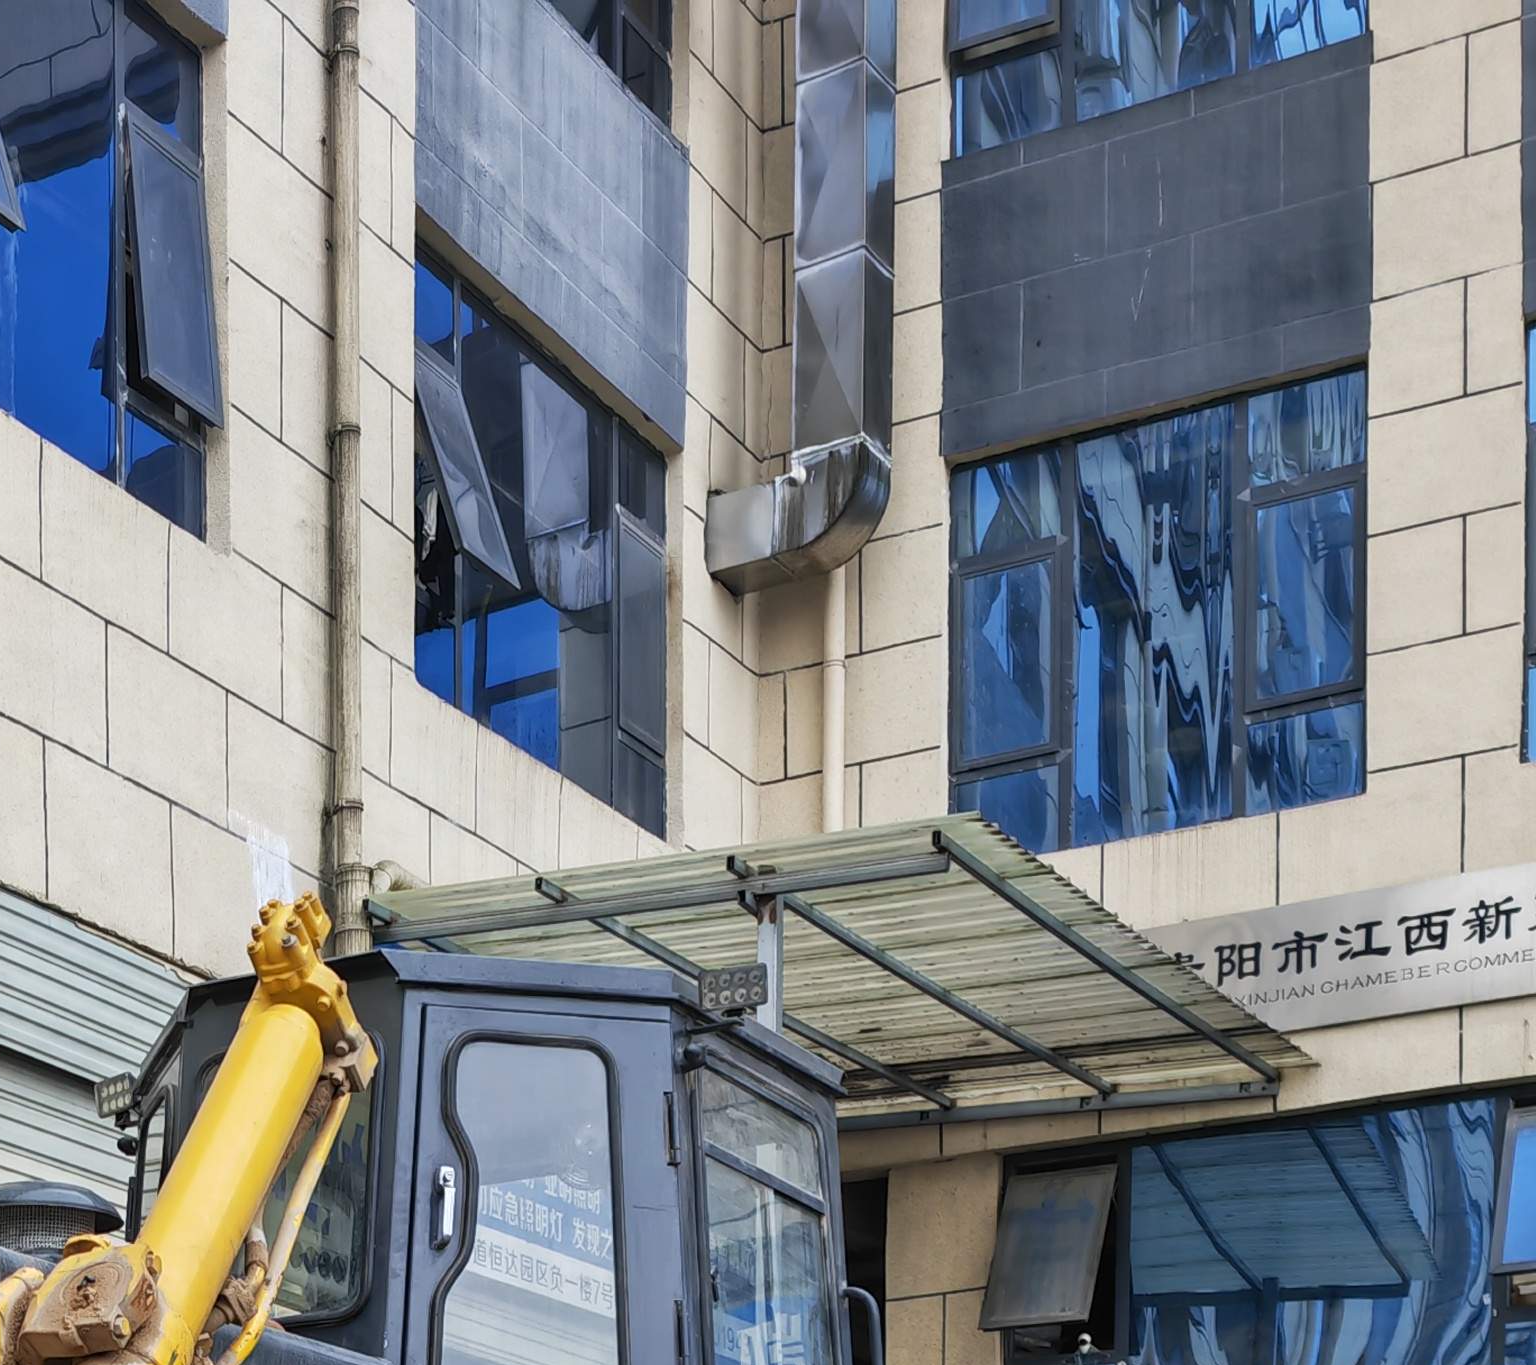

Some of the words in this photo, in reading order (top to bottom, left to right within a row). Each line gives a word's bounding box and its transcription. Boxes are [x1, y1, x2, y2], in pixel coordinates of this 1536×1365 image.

[1173, 896, 1536, 987] 阳市江西新
